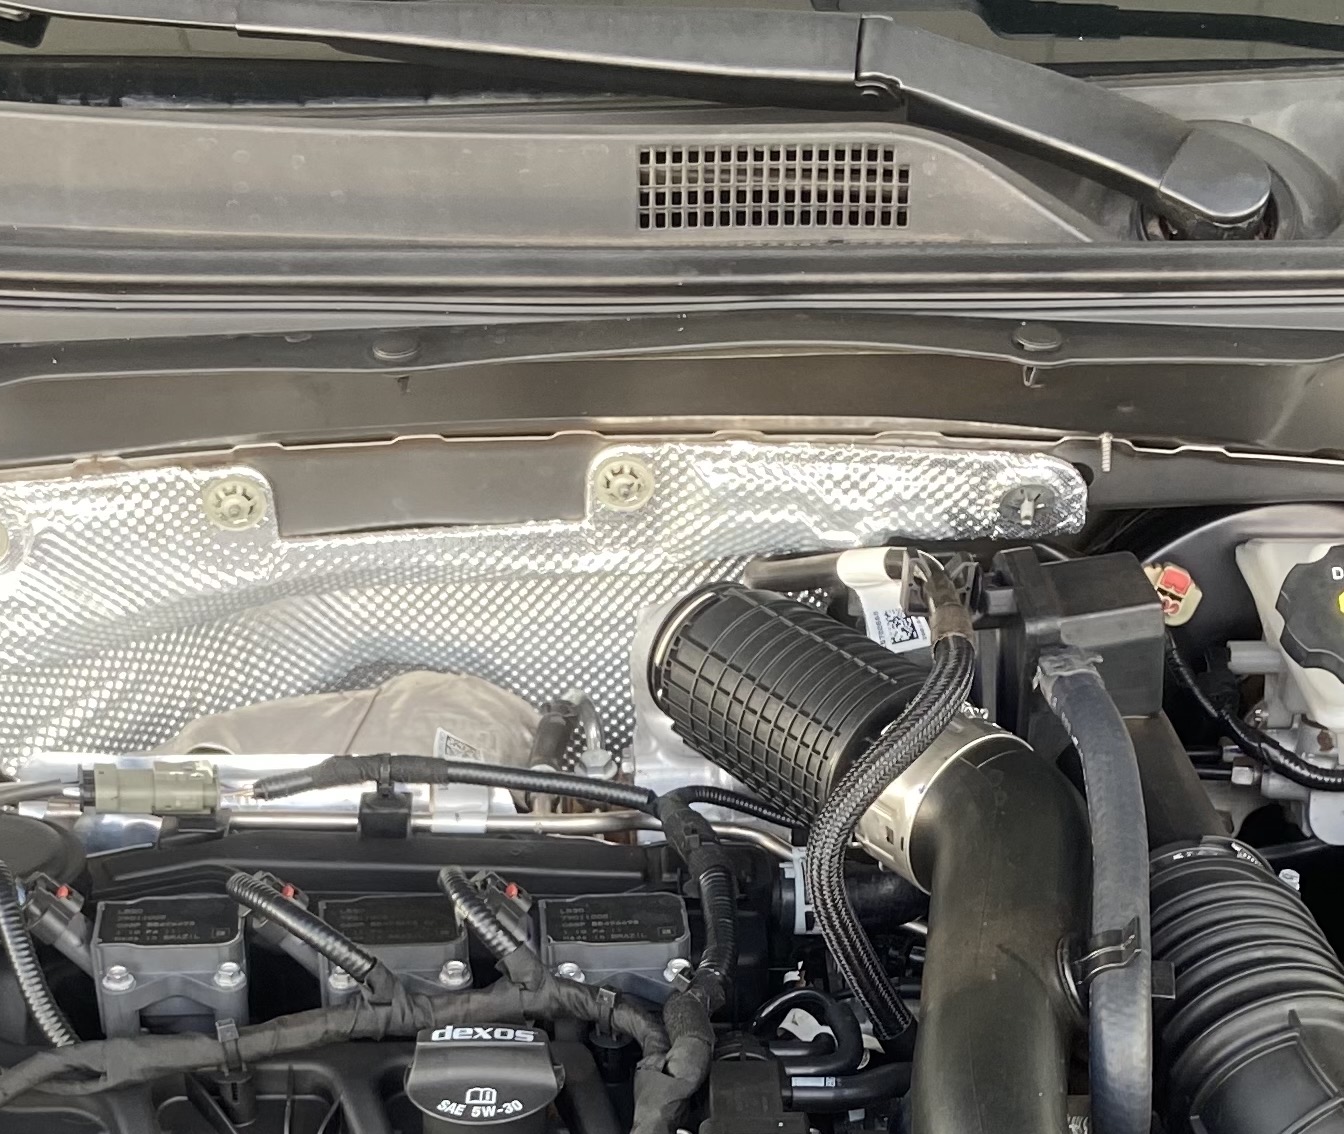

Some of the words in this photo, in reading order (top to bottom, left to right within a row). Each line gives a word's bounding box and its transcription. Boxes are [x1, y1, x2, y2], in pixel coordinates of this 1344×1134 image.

[431, 1025, 535, 1042] dexos
[436, 1099, 467, 1116] SAE
[471, 1099, 524, 1118] 5W-30
